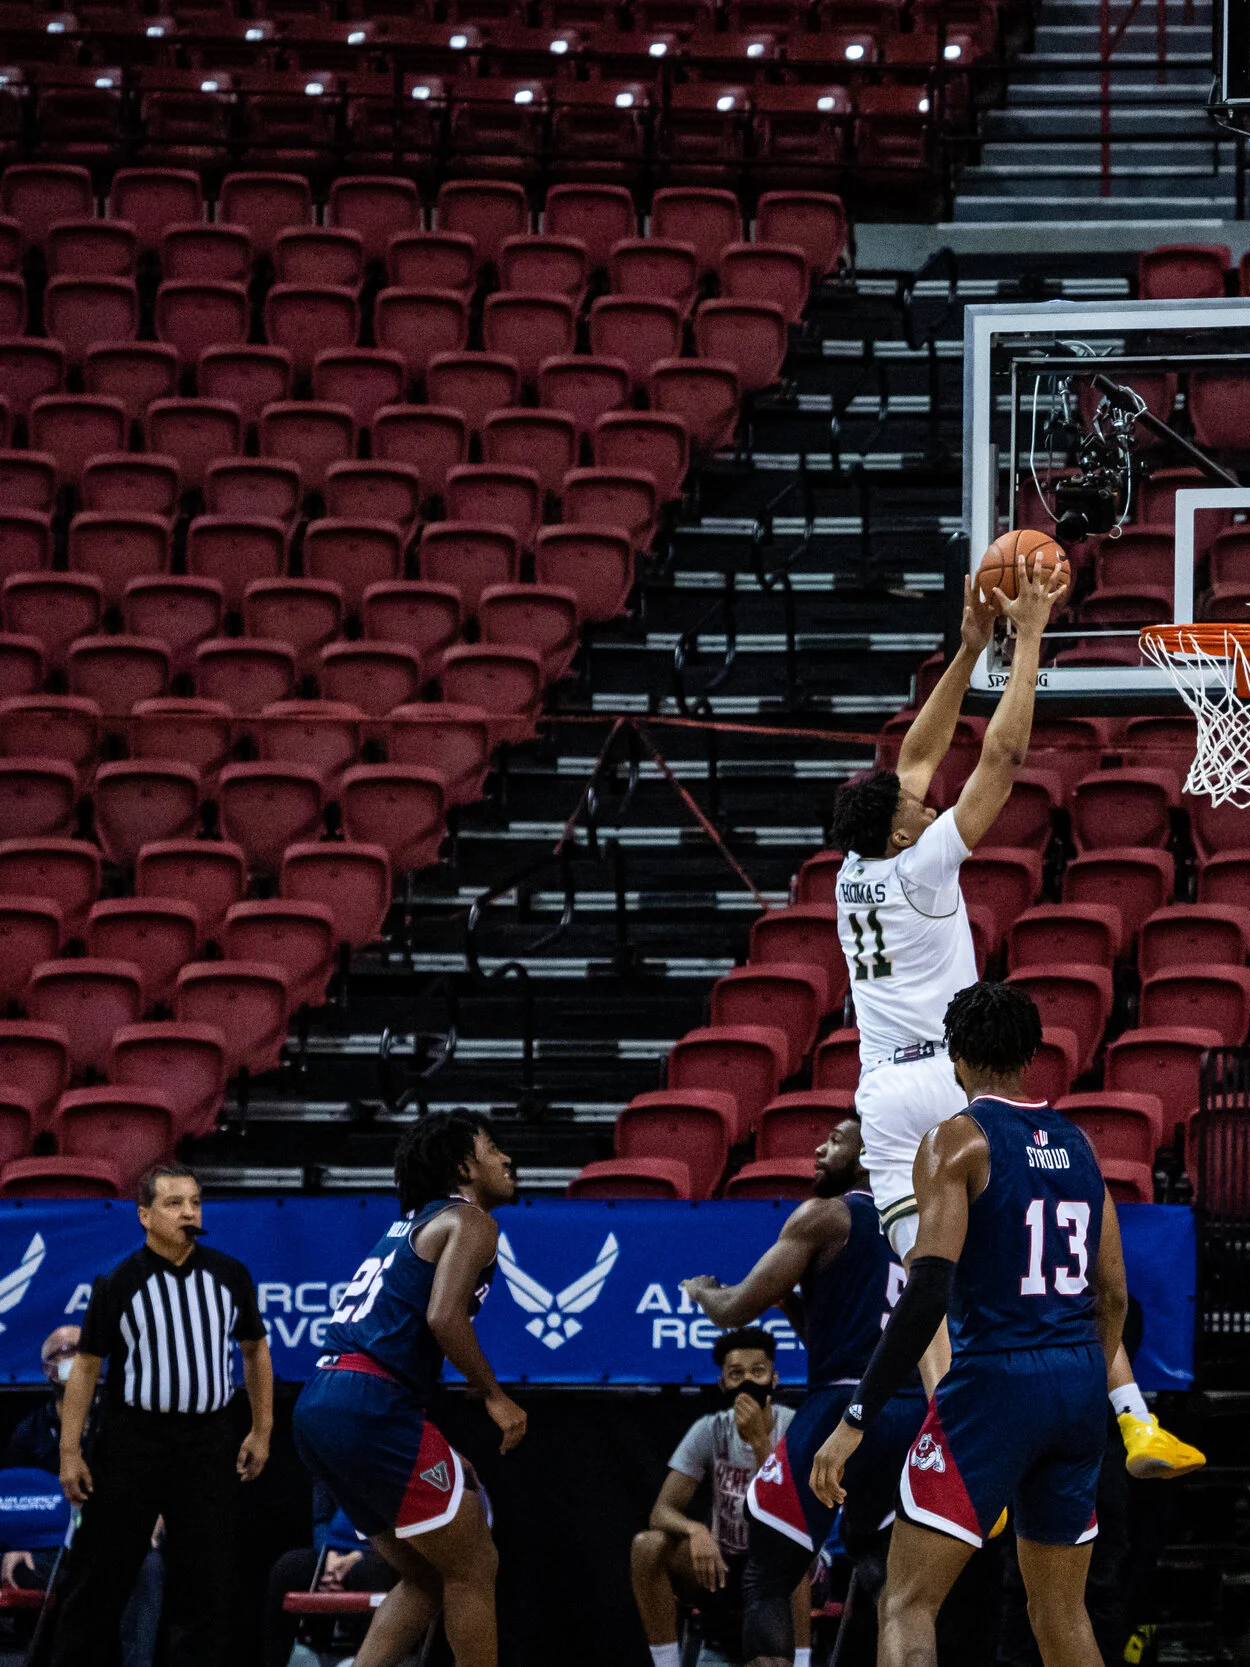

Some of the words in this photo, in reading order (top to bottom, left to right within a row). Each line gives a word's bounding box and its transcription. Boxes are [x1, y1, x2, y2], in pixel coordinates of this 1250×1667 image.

[848, 908, 892, 981] 11
[1026, 1146, 1070, 1169] STROUD
[1020, 1198, 1091, 1296] 13
